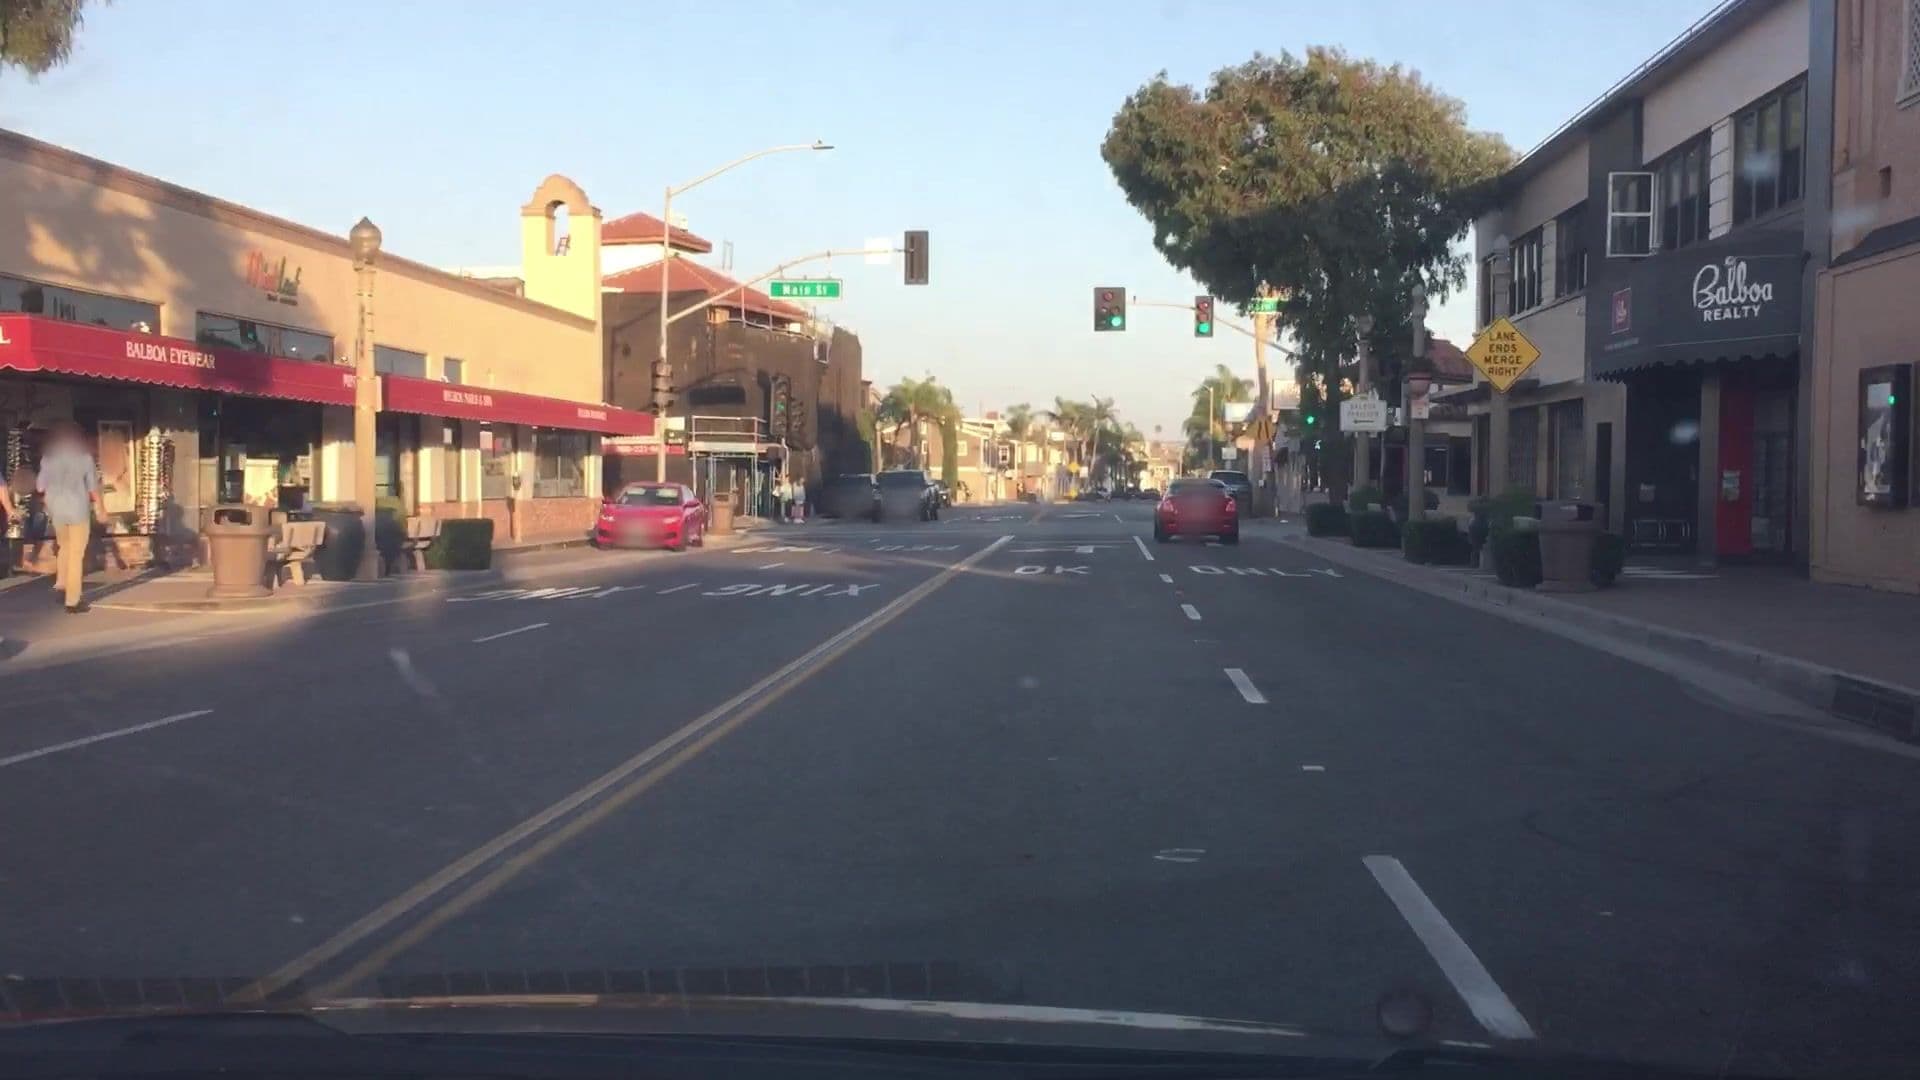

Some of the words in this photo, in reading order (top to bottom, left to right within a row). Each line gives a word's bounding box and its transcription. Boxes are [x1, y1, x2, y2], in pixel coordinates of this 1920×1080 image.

[1692, 256, 1773, 309] Balboa
[782, 284, 811, 296] Main
[816, 284, 828, 296] St
[1703, 304, 1761, 322] REALTY
[1488, 332, 1517, 342] LANE
[1488, 343, 1518, 353] ENDS
[125, 341, 167, 363] BALBOA
[169, 347, 216, 369] EYEWEAR
[1484, 355, 1523, 365] MERGE
[1488, 366, 1518, 377] RIGHT
[1013, 564, 1090, 576] OK
[1187, 564, 1344, 578] ONLY
[702, 583, 881, 597] XING
